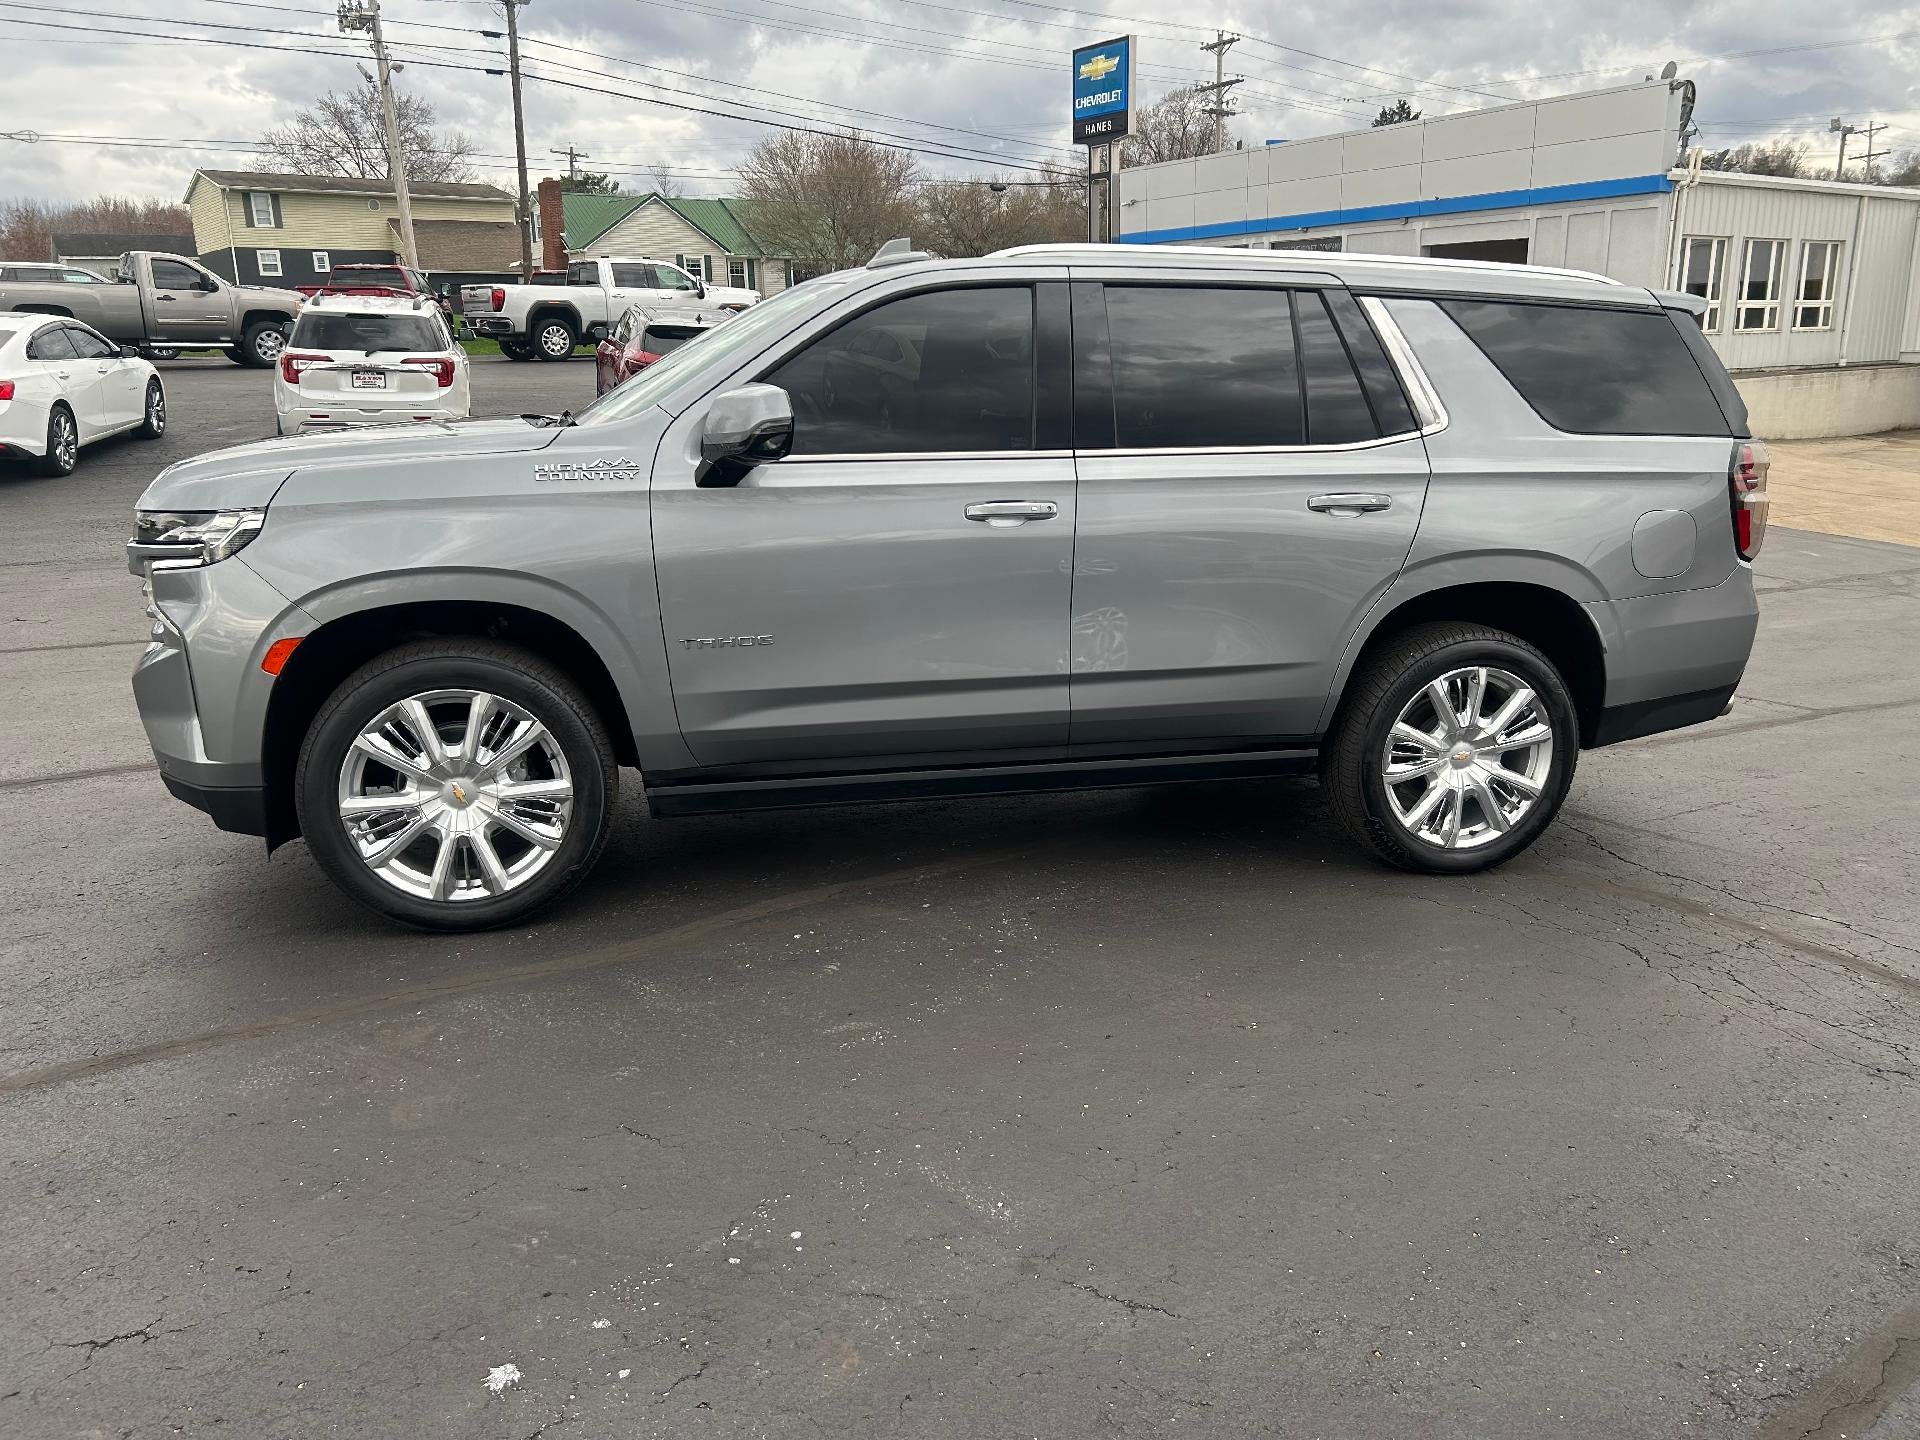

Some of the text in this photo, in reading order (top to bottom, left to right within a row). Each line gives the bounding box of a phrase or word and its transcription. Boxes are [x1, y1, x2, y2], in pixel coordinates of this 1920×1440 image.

[1075, 89, 1123, 109] CHEVROLET
[1085, 120, 1112, 135] HANES
[534, 463, 587, 472] HIGH
[535, 470, 640, 481] COUNTRY
[679, 634, 775, 650] TAHOE
